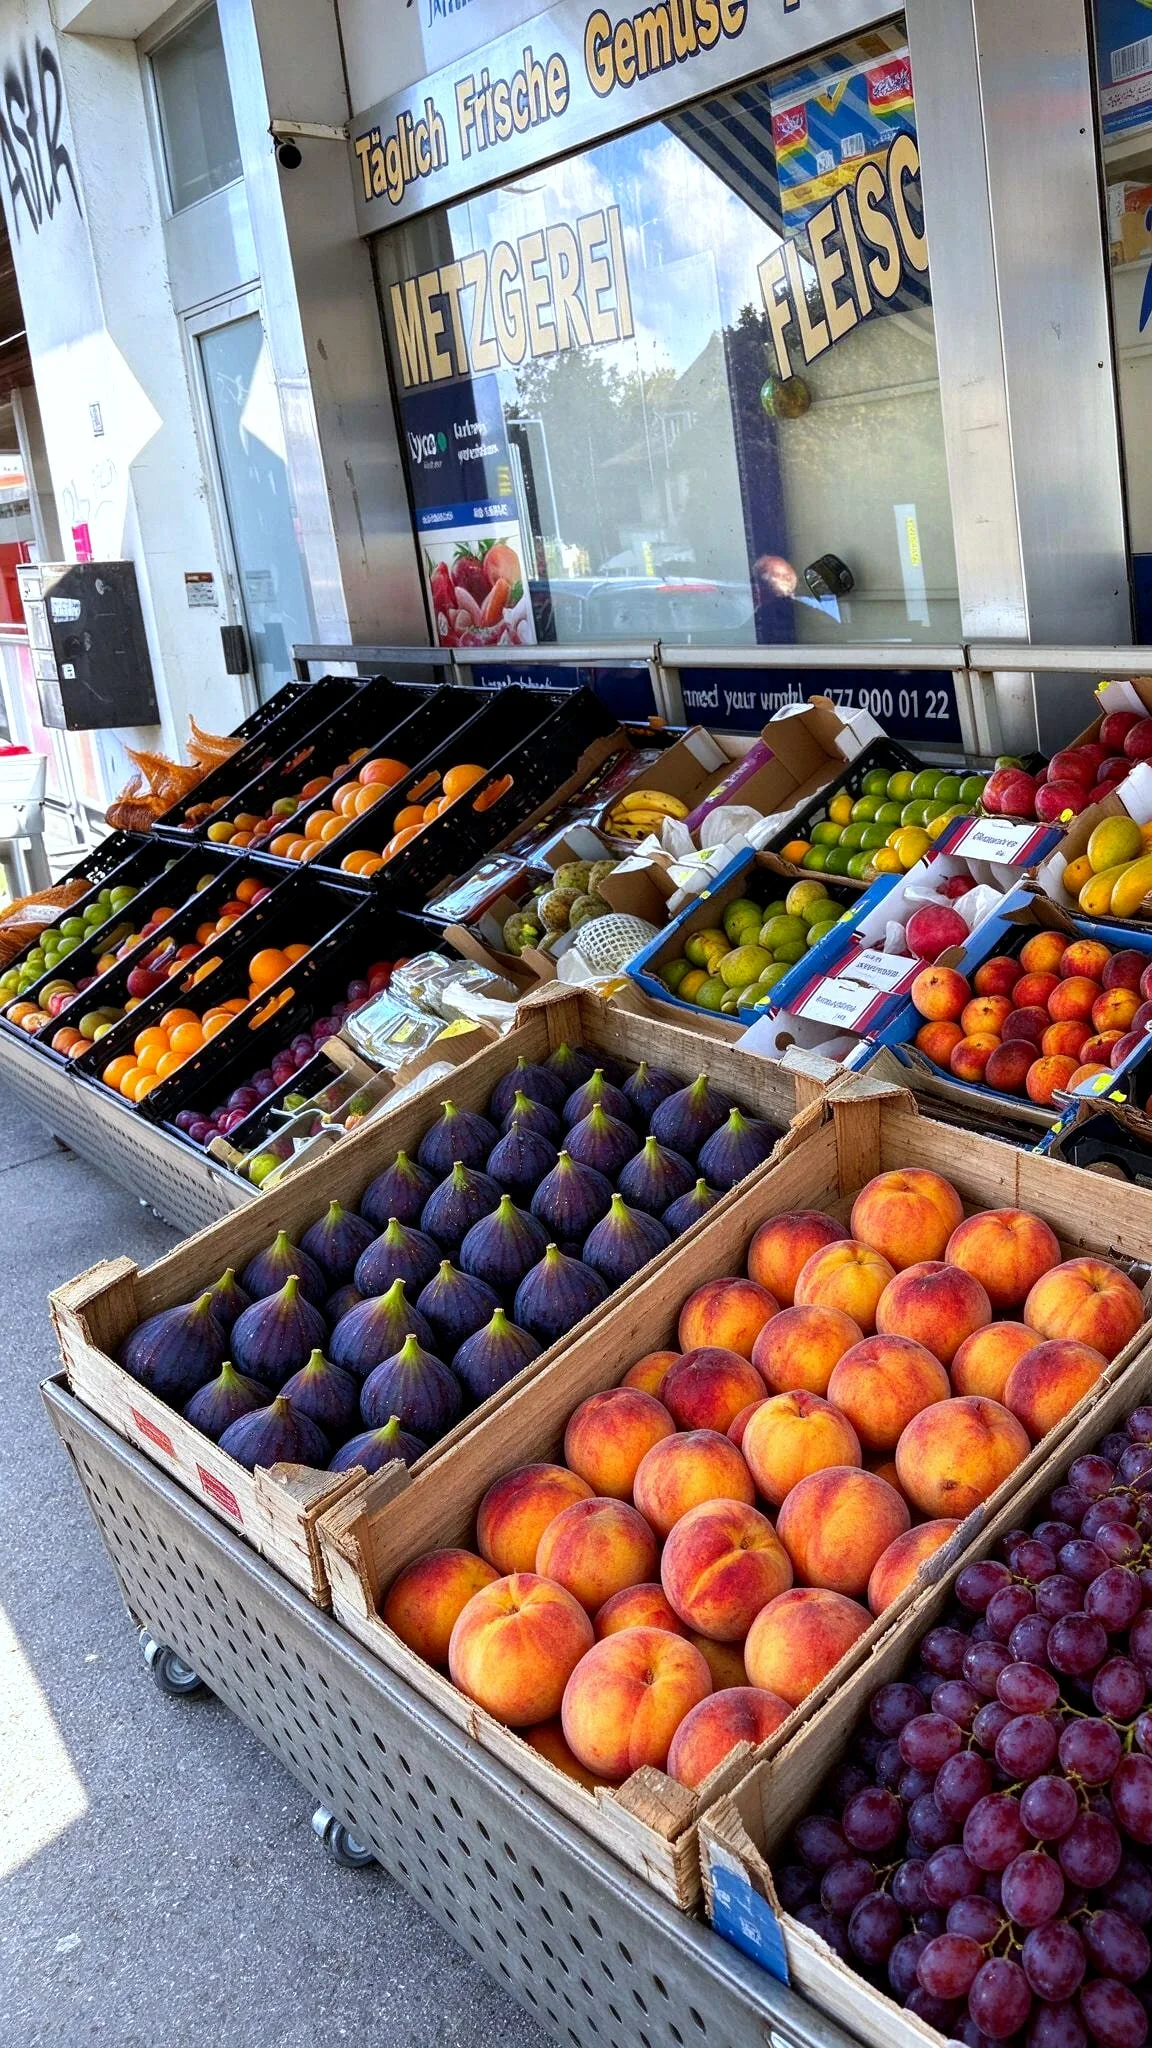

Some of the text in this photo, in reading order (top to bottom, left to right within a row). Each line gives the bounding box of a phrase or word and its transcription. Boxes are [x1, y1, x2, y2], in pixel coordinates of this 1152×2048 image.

[355, 97, 449, 205] Täglich
[454, 45, 570, 161] Frische
[390, 203, 635, 388] METZGEREI
[757, 131, 931, 382] FLEISC
[858, 688, 894, 718] 900
[898, 689, 919, 719] 01
[924, 690, 950, 719] 22
